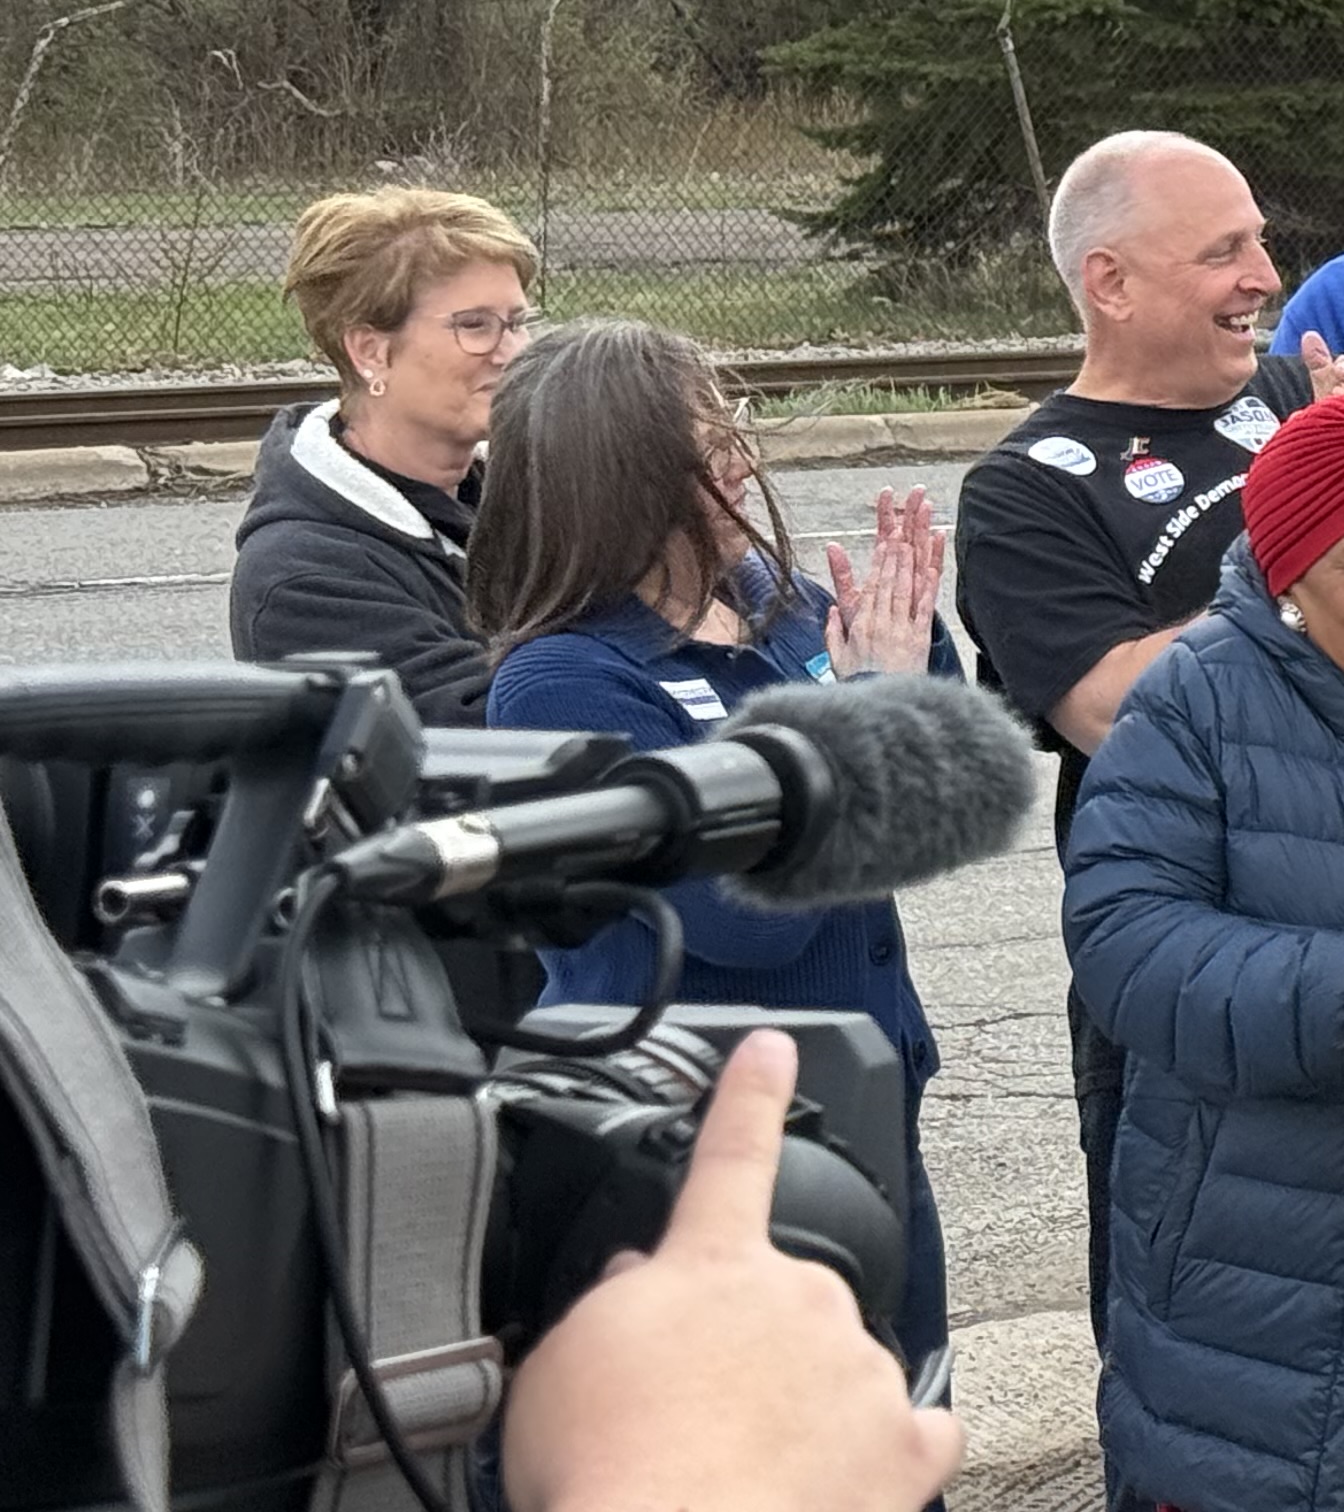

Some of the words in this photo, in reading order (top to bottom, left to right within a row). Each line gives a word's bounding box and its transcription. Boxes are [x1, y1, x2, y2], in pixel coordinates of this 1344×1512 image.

[1130, 469, 1179, 491] VOTE
[1138, 535, 1175, 585] West
[1165, 505, 1200, 539] Side
